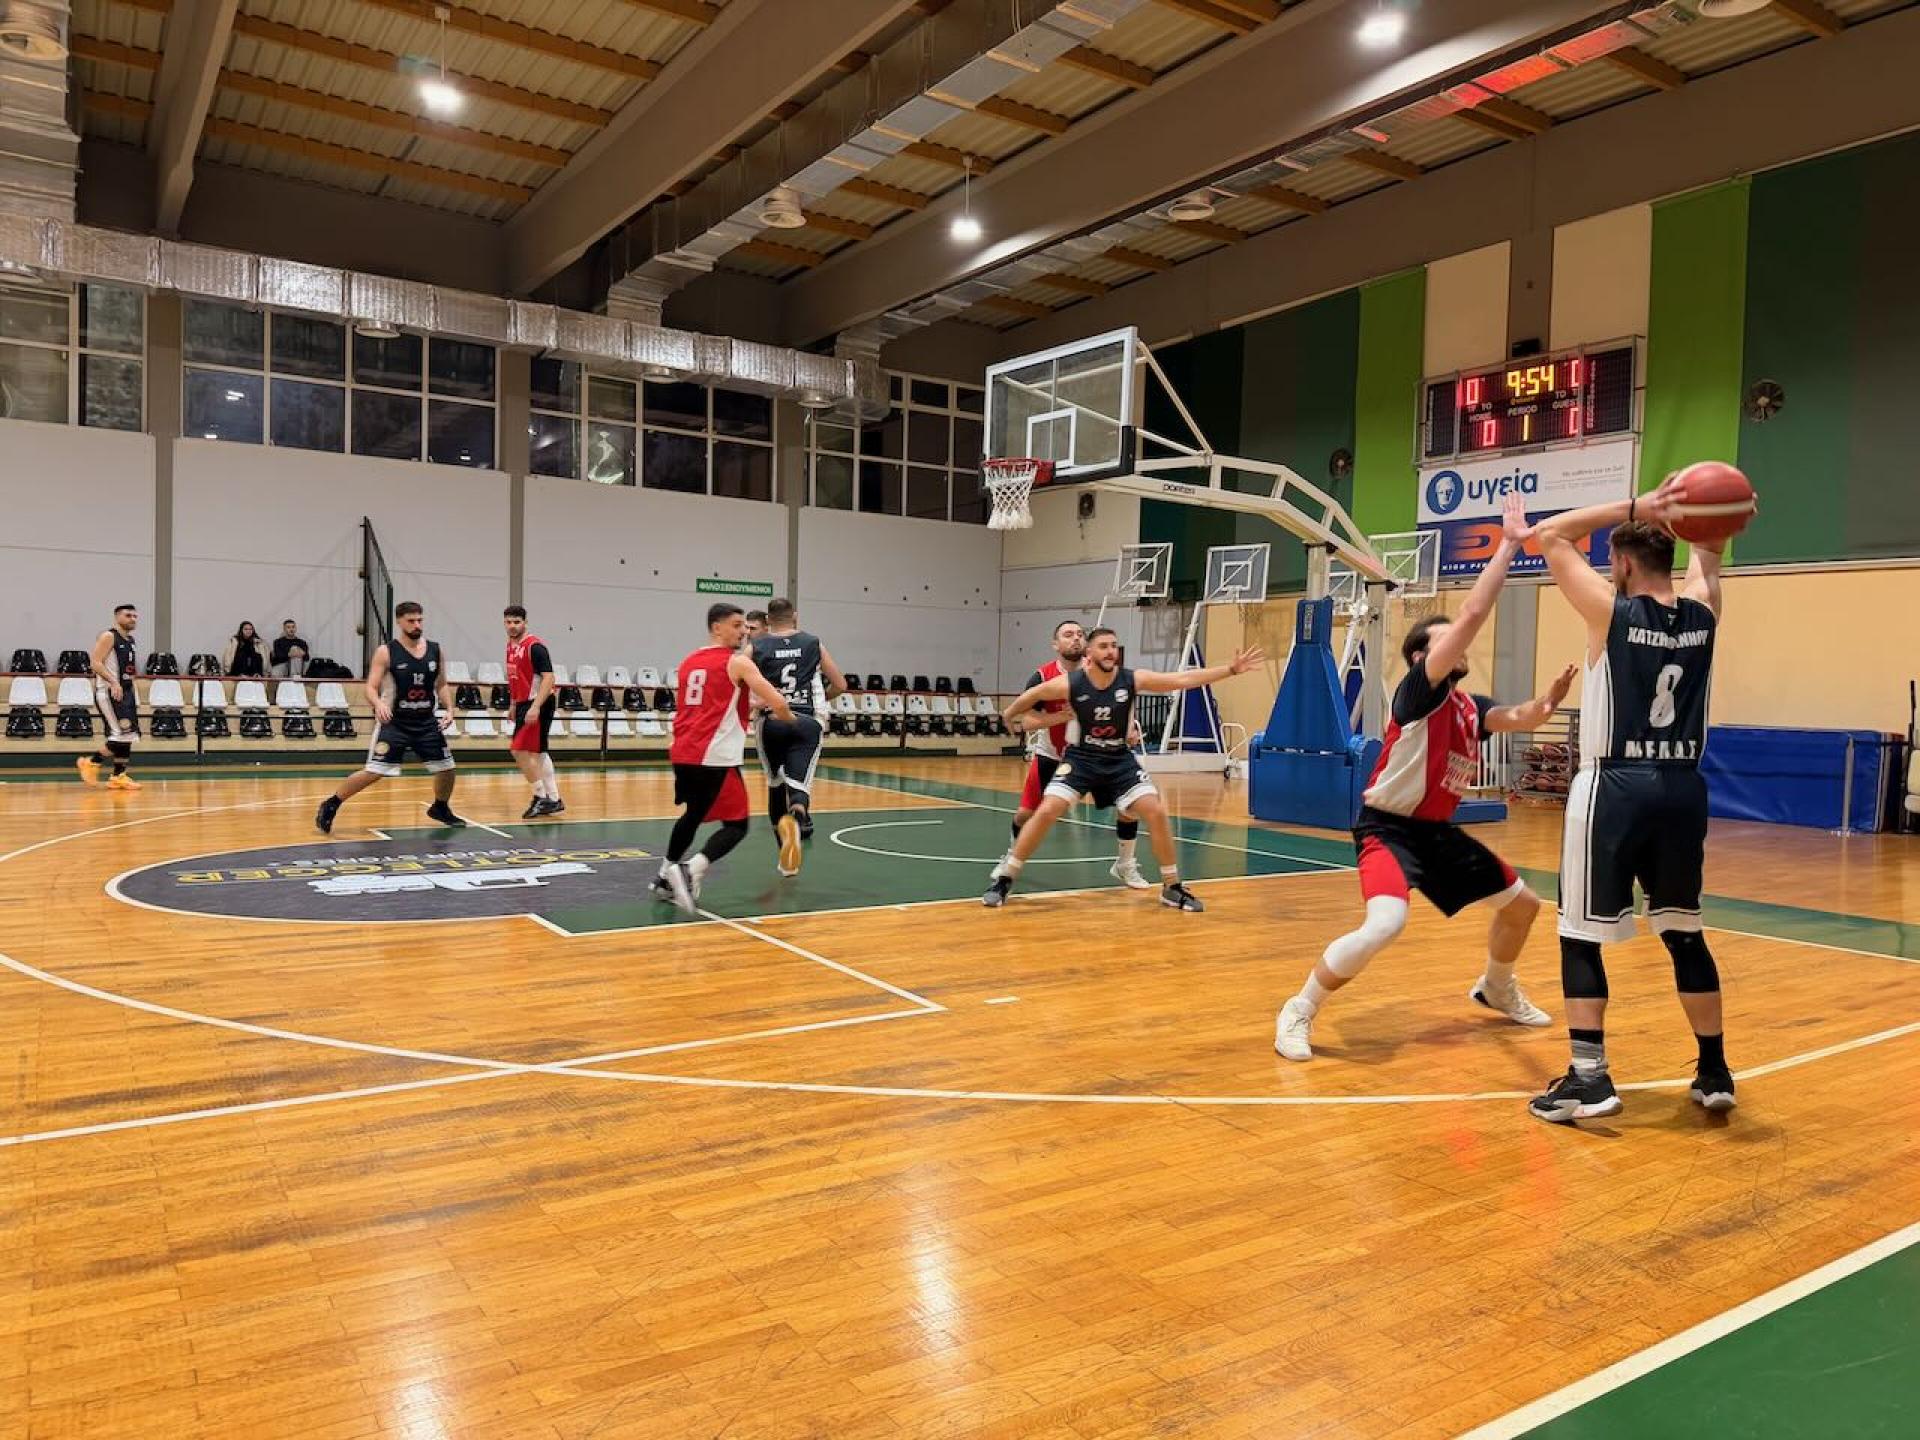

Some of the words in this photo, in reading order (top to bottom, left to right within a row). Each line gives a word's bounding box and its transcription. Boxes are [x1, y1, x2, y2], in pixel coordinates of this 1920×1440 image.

[1466, 377, 1480, 405] 0
[1507, 364, 1554, 397] 9:54
[1507, 404, 1538, 416] PERIOD
[1482, 419, 1496, 446] 0
[1523, 414, 1530, 441] 1
[1470, 558, 1543, 569] PERMANCE
[413, 672, 425, 685] 12
[685, 669, 707, 705] 8
[780, 663, 797, 692] 5
[1649, 664, 1684, 728] 8
[1094, 705, 1111, 720] 22
[177, 849, 651, 883] BOOTLEGGER
